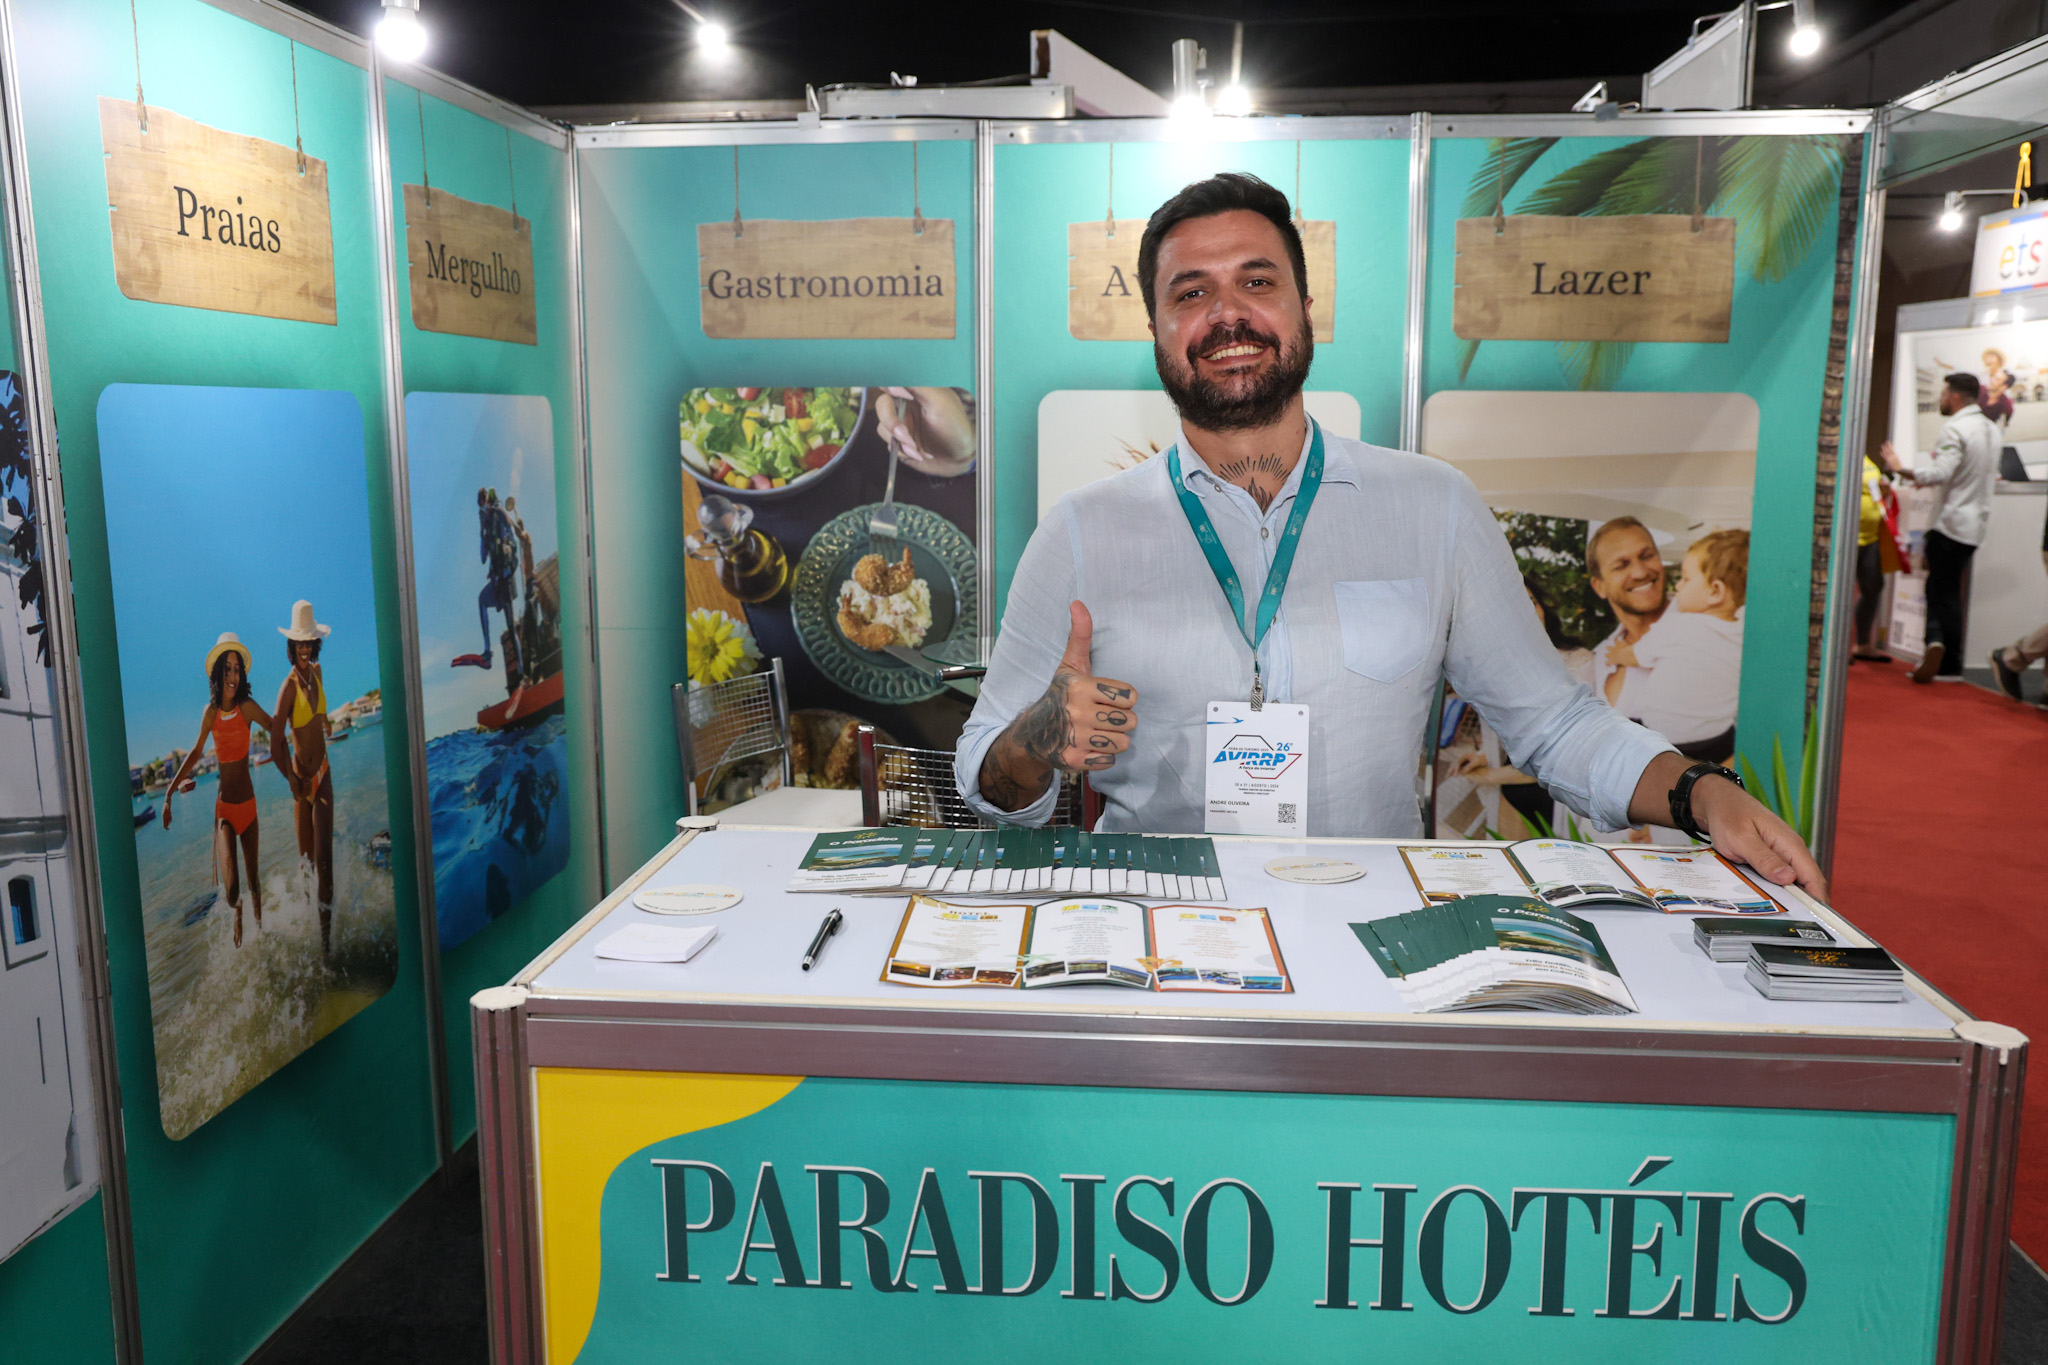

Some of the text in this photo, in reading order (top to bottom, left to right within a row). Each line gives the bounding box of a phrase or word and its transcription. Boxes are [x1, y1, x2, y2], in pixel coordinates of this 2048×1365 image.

[173, 185, 282, 254] Praias
[425, 239, 522, 299] Mergulho
[1999, 233, 2042, 279] ets
[707, 265, 944, 300] Gastronomia
[1531, 262, 1652, 295] Lazer
[1213, 750, 1287, 767] AVIRRP
[842, 836, 899, 846] Paradiso
[1513, 908, 1580, 932] Paradiso
[650, 1155, 1808, 1325] PARADISO HOTÉIS
